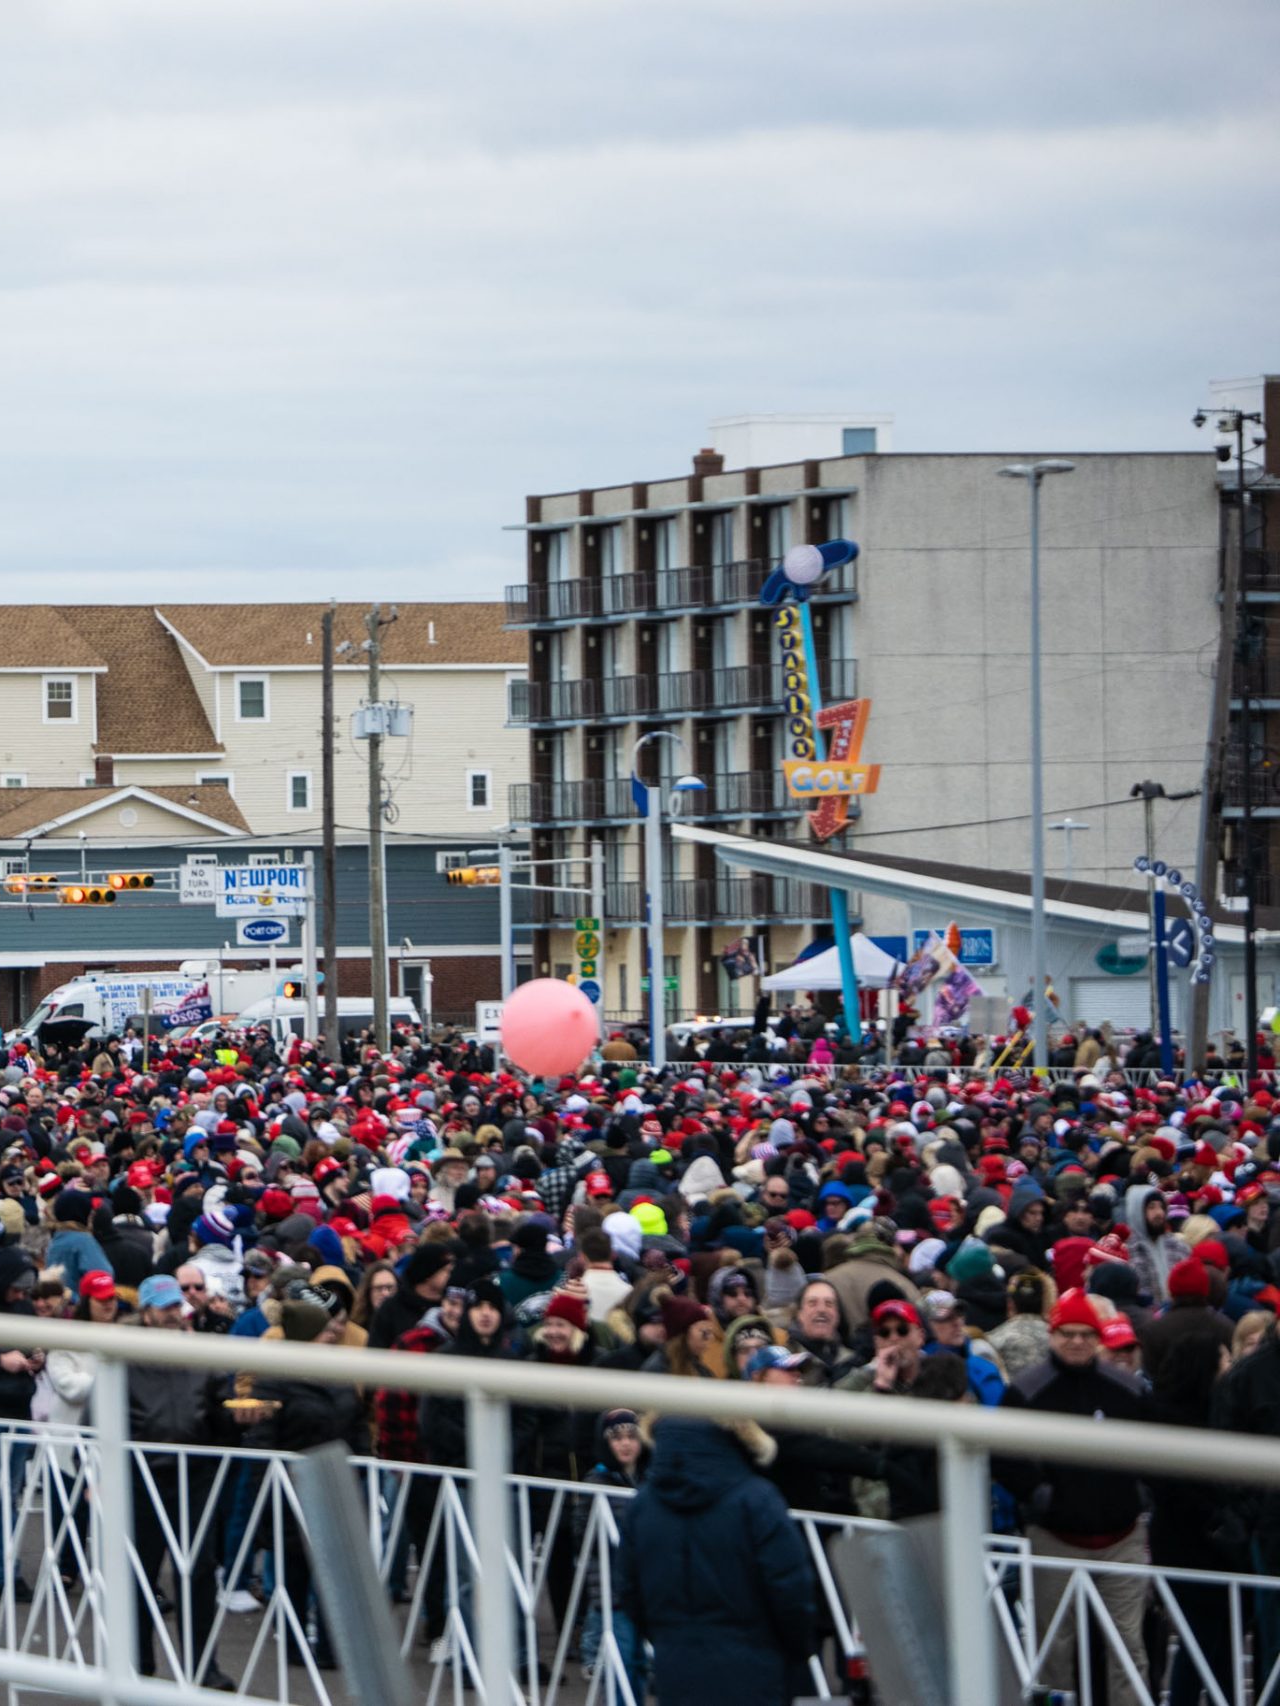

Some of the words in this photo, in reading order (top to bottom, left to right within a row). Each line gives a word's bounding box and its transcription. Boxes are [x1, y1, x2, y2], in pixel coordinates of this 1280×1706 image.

[792, 766, 865, 792] GOLF
[191, 869, 205, 877] NO
[188, 880, 209, 888] TURN
[197, 890, 214, 898] RED
